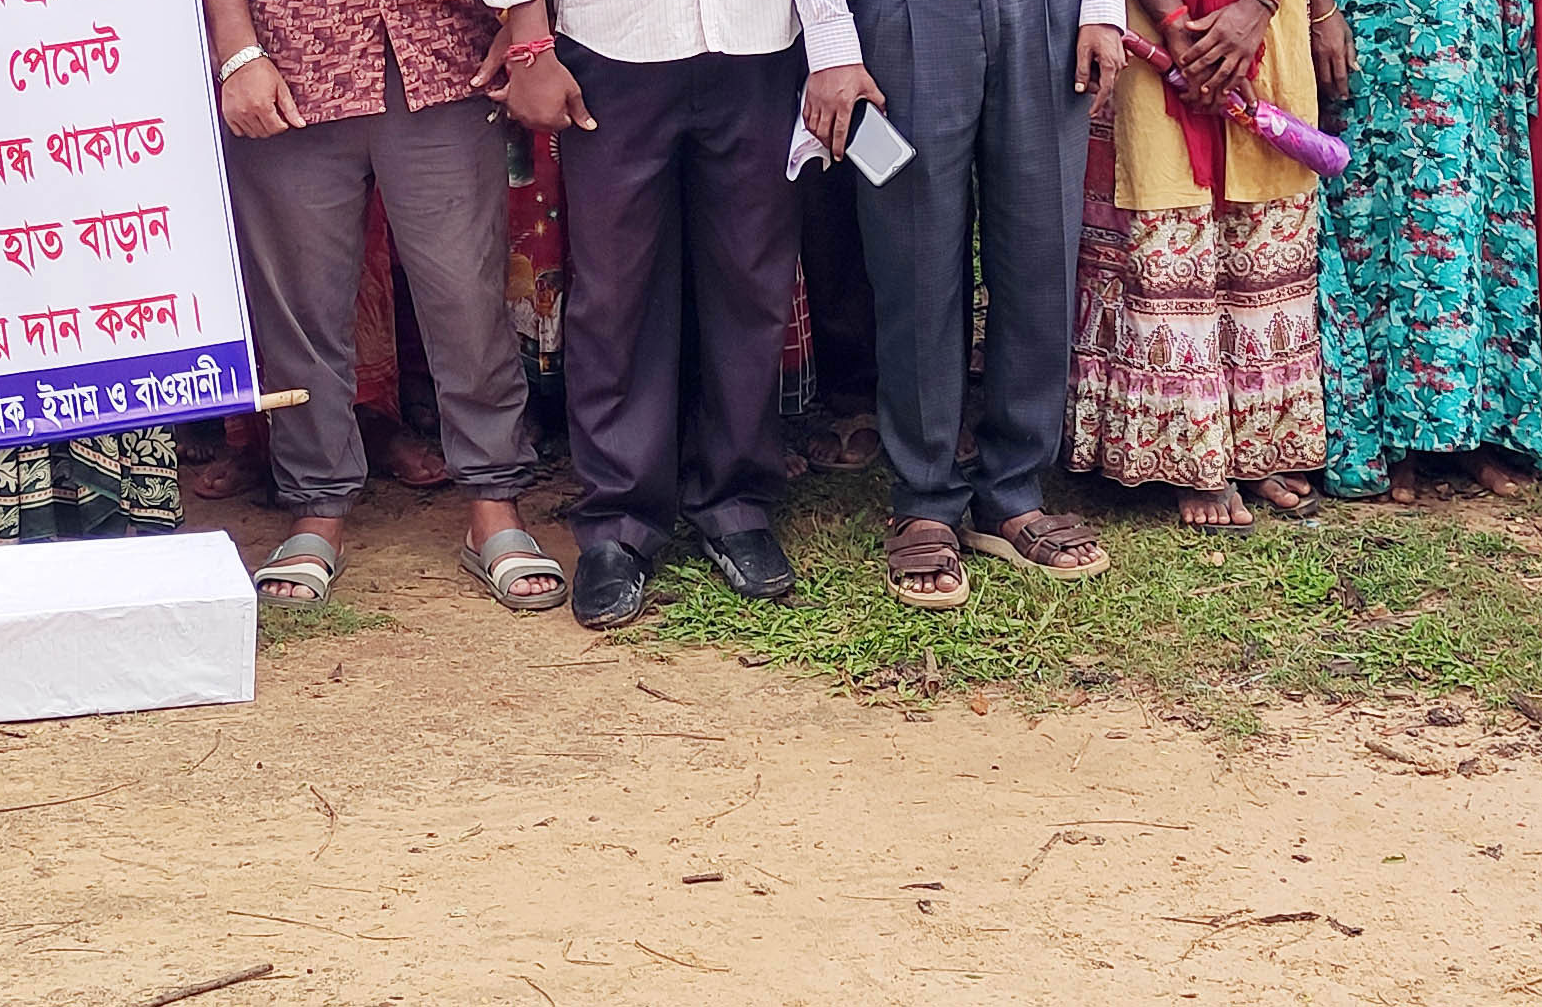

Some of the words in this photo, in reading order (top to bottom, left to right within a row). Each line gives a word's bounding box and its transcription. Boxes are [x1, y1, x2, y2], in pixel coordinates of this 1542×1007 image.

[9, 25, 120, 91] পেমেন্ট
[47, 118, 163, 173] থাকাতে
[73, 206, 169, 263] বাড়ান
[19, 308, 81, 354] দান
[36, 380, 100, 429] ইমাম
[105, 381, 127, 409] ও
